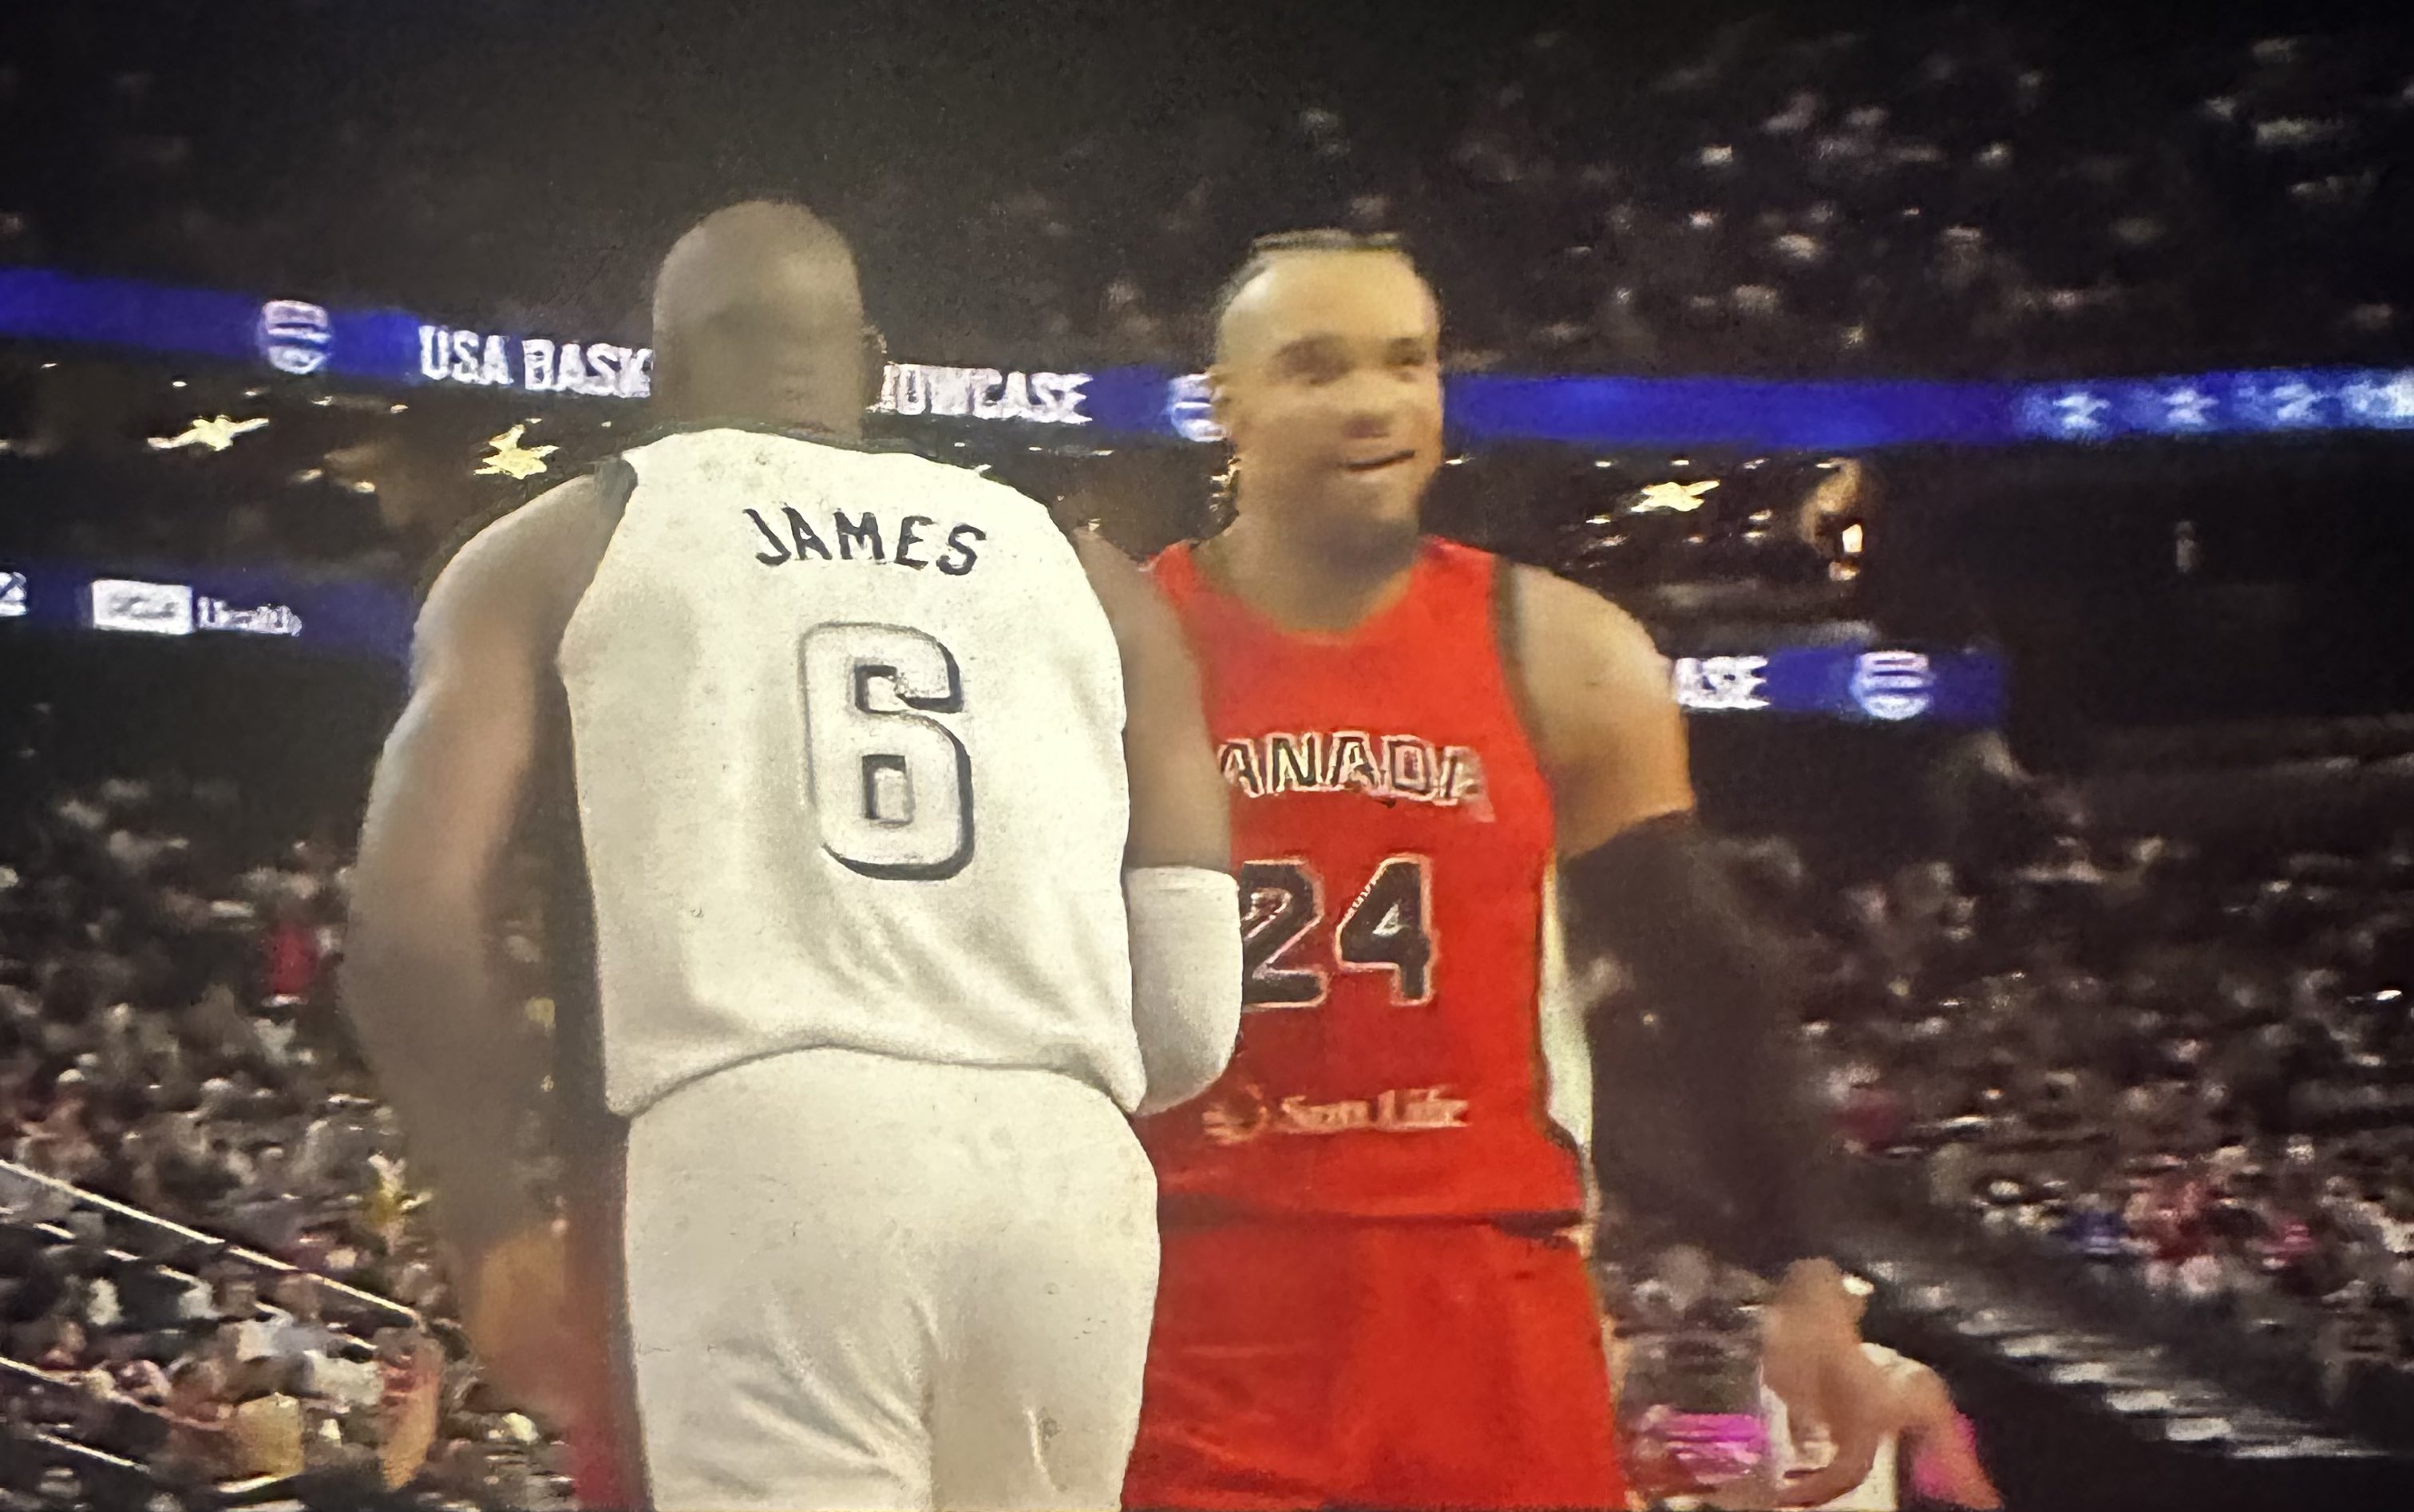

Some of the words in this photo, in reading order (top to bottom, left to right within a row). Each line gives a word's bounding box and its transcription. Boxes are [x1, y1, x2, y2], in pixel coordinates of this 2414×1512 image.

[418, 324, 514, 386] USA
[881, 362, 1094, 425] OWCASE
[742, 503, 987, 576] JAMES
[798, 620, 975, 881] 6
[1241, 852, 1439, 1009] 24
